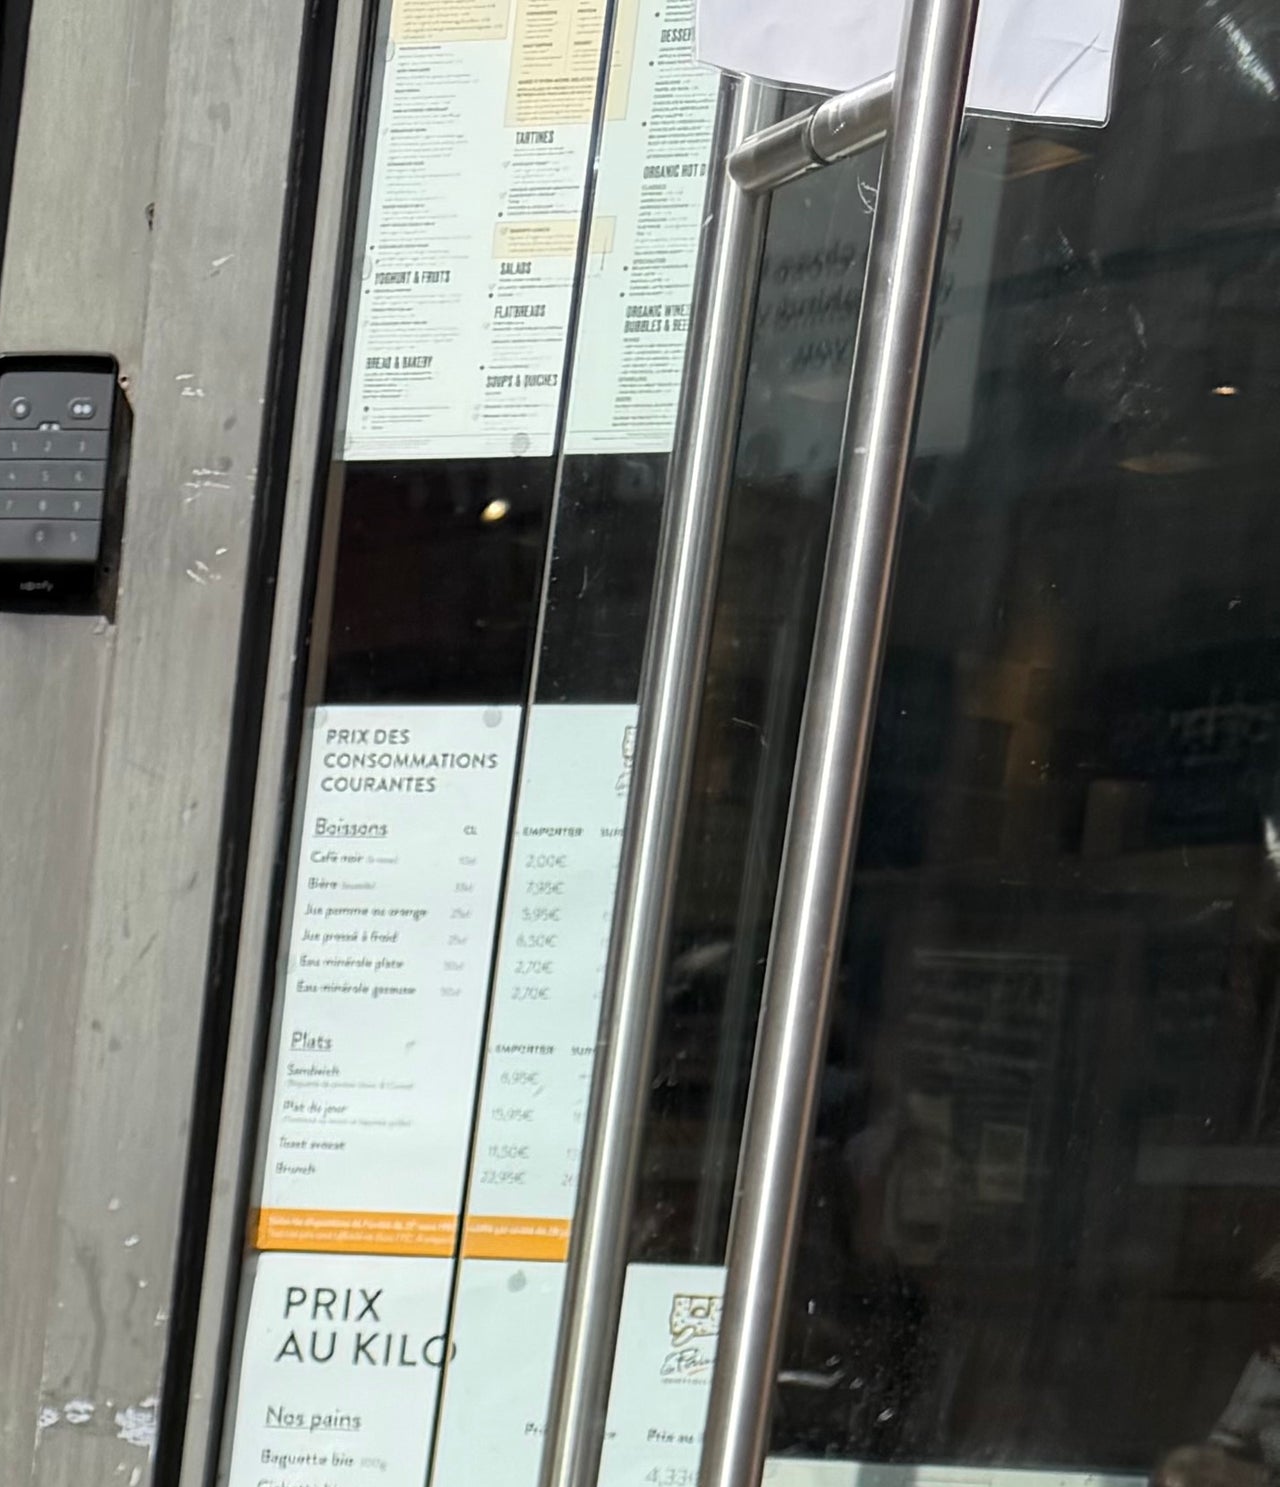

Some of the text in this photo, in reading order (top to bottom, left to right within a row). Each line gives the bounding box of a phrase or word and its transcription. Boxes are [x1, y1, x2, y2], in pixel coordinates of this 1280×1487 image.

[515, 130, 555, 145] TARTINES
[500, 261, 532, 276] SALADS
[421, 270, 451, 284] FRUITS
[494, 304, 547, 318] FLATBREADS
[366, 357, 392, 370] BREAD
[402, 356, 433, 369] BAKERY
[326, 729, 411, 745] PRIX DES
[323, 753, 499, 769] CONSOMMATIONS
[320, 777, 437, 792] COURANTES
[313, 817, 388, 837] Boissons
[290, 1031, 333, 1050] Plats
[283, 1286, 383, 1322] PRIX
[274, 1330, 457, 1368] AU KILO
[264, 1404, 362, 1433] Nos pains
[261, 1448, 327, 1470] Baguette
[332, 1452, 354, 1467] bio
